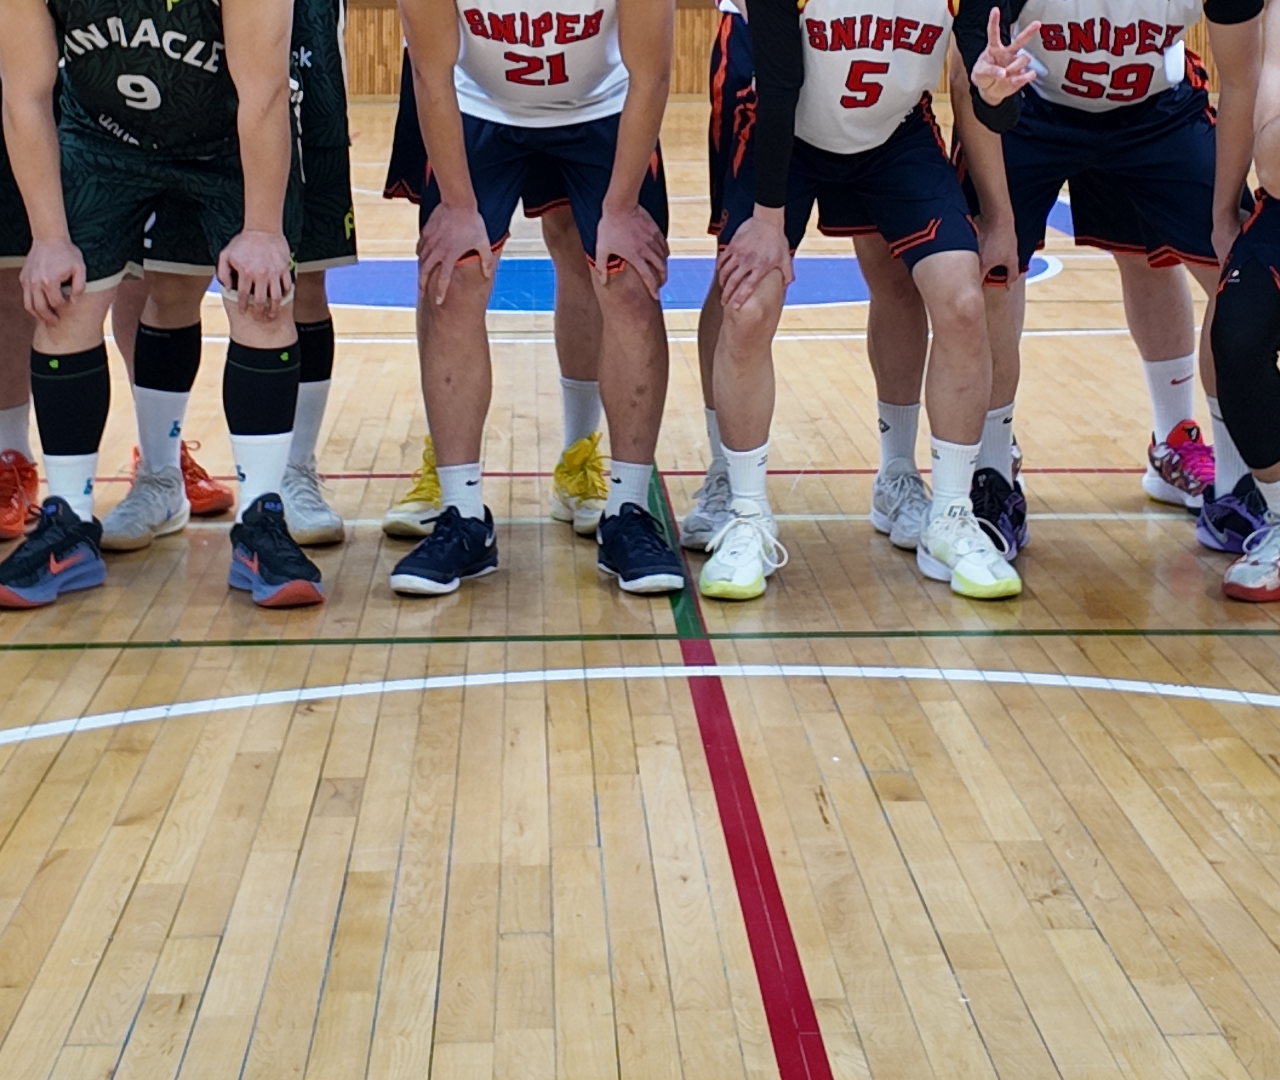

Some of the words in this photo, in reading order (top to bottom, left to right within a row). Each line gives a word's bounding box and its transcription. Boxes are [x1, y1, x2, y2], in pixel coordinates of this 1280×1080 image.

[463, 8, 604, 47] SNIPER
[805, 14, 943, 55] SNIPER
[504, 51, 569, 86] 21
[840, 60, 890, 109] 5
[1061, 58, 1154, 102] 59
[116, 74, 161, 110] 9
